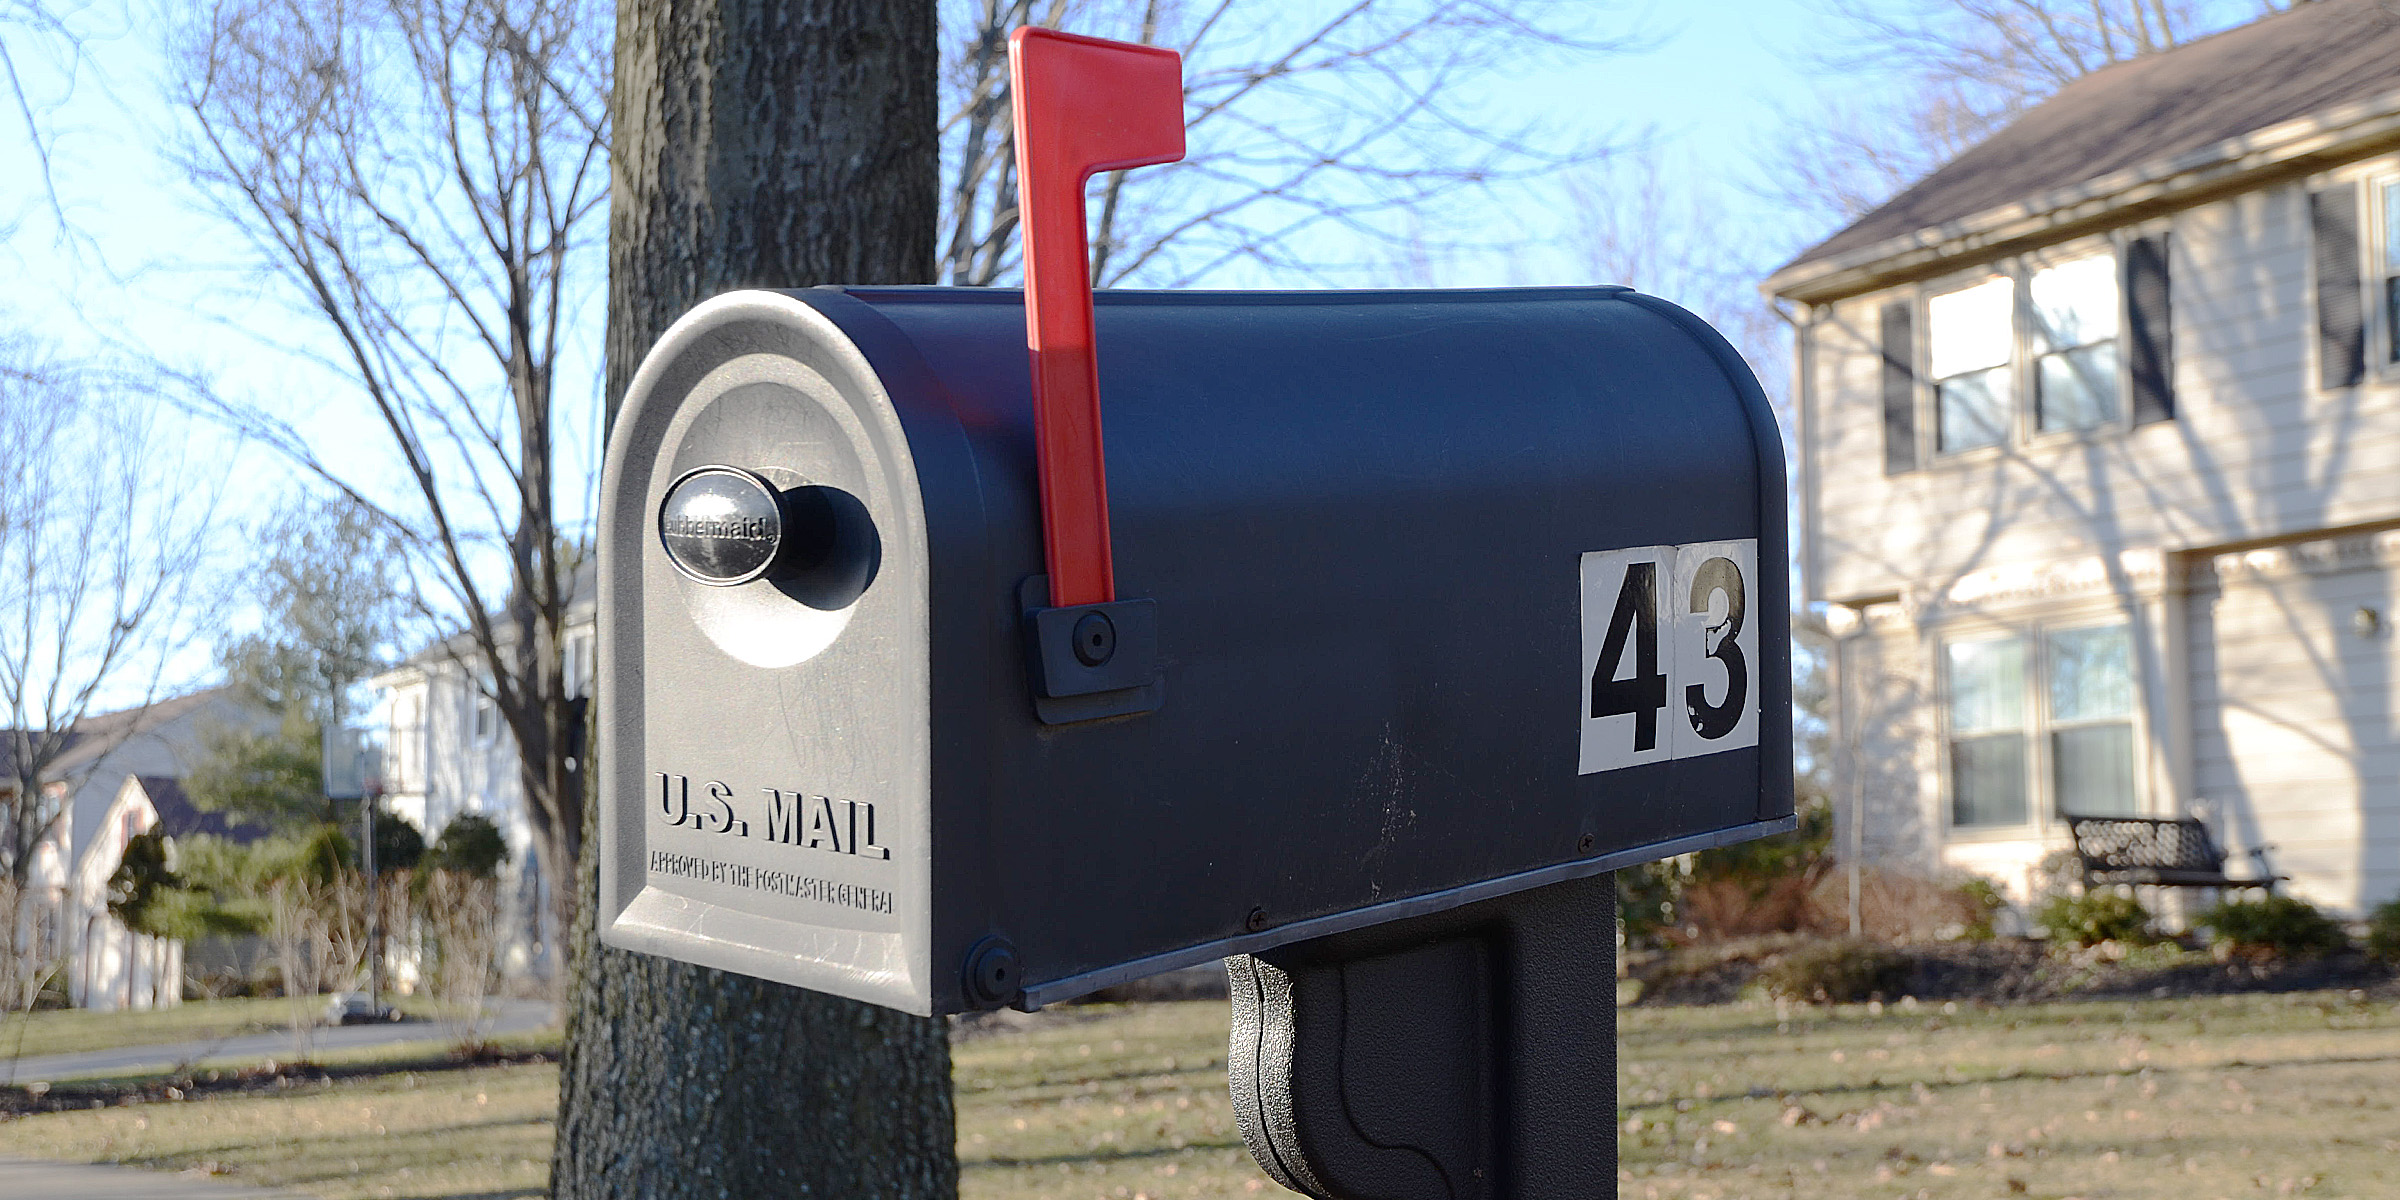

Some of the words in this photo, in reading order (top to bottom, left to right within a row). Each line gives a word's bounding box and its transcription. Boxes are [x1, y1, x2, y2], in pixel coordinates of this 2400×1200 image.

[1591, 556, 1748, 752] 43
[654, 771, 748, 837] U.S.
[762, 787, 890, 860] MAIL
[650, 850, 709, 880] APPROVED
[712, 860, 727, 883] BY
[730, 864, 753, 888] THE
[756, 868, 835, 904] POSTMASTER
[838, 883, 894, 915] GENERAL
